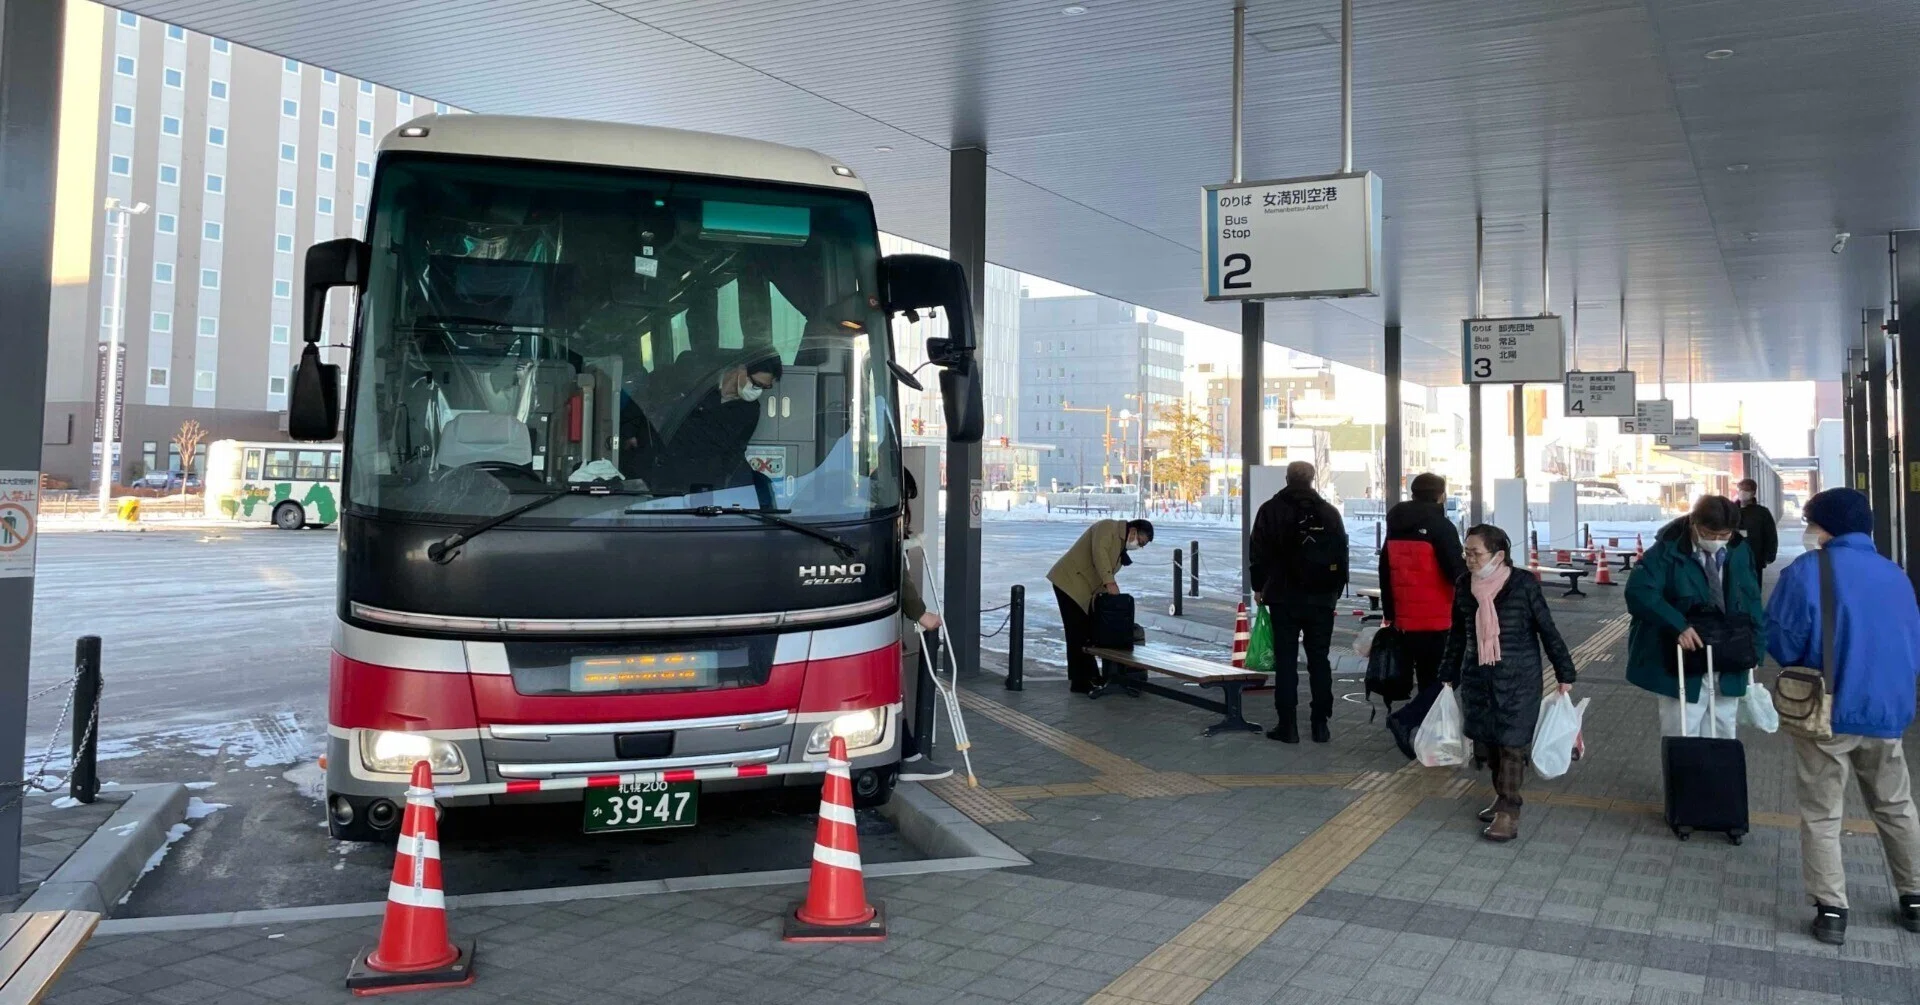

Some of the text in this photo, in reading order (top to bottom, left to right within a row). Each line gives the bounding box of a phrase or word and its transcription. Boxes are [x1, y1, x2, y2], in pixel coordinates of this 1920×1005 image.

[1220, 194, 1252, 208] のりば
[1262, 187, 1337, 208] 女満別空港
[1225, 215, 1248, 226] Bus
[1222, 228, 1251, 240] Stop
[1223, 252, 1252, 290] 2
[1498, 323, 1535, 333] 卸売団地
[1473, 343, 1491, 351] Stop
[1498, 337, 1517, 346] 常呂
[1474, 357, 1492, 378] 3
[1571, 399, 1585, 414] 4
[1624, 421, 1634, 433] 5
[1659, 435, 1668, 444] 6
[798, 563, 866, 577] HINO
[606, 792, 691, 826] 39-47
